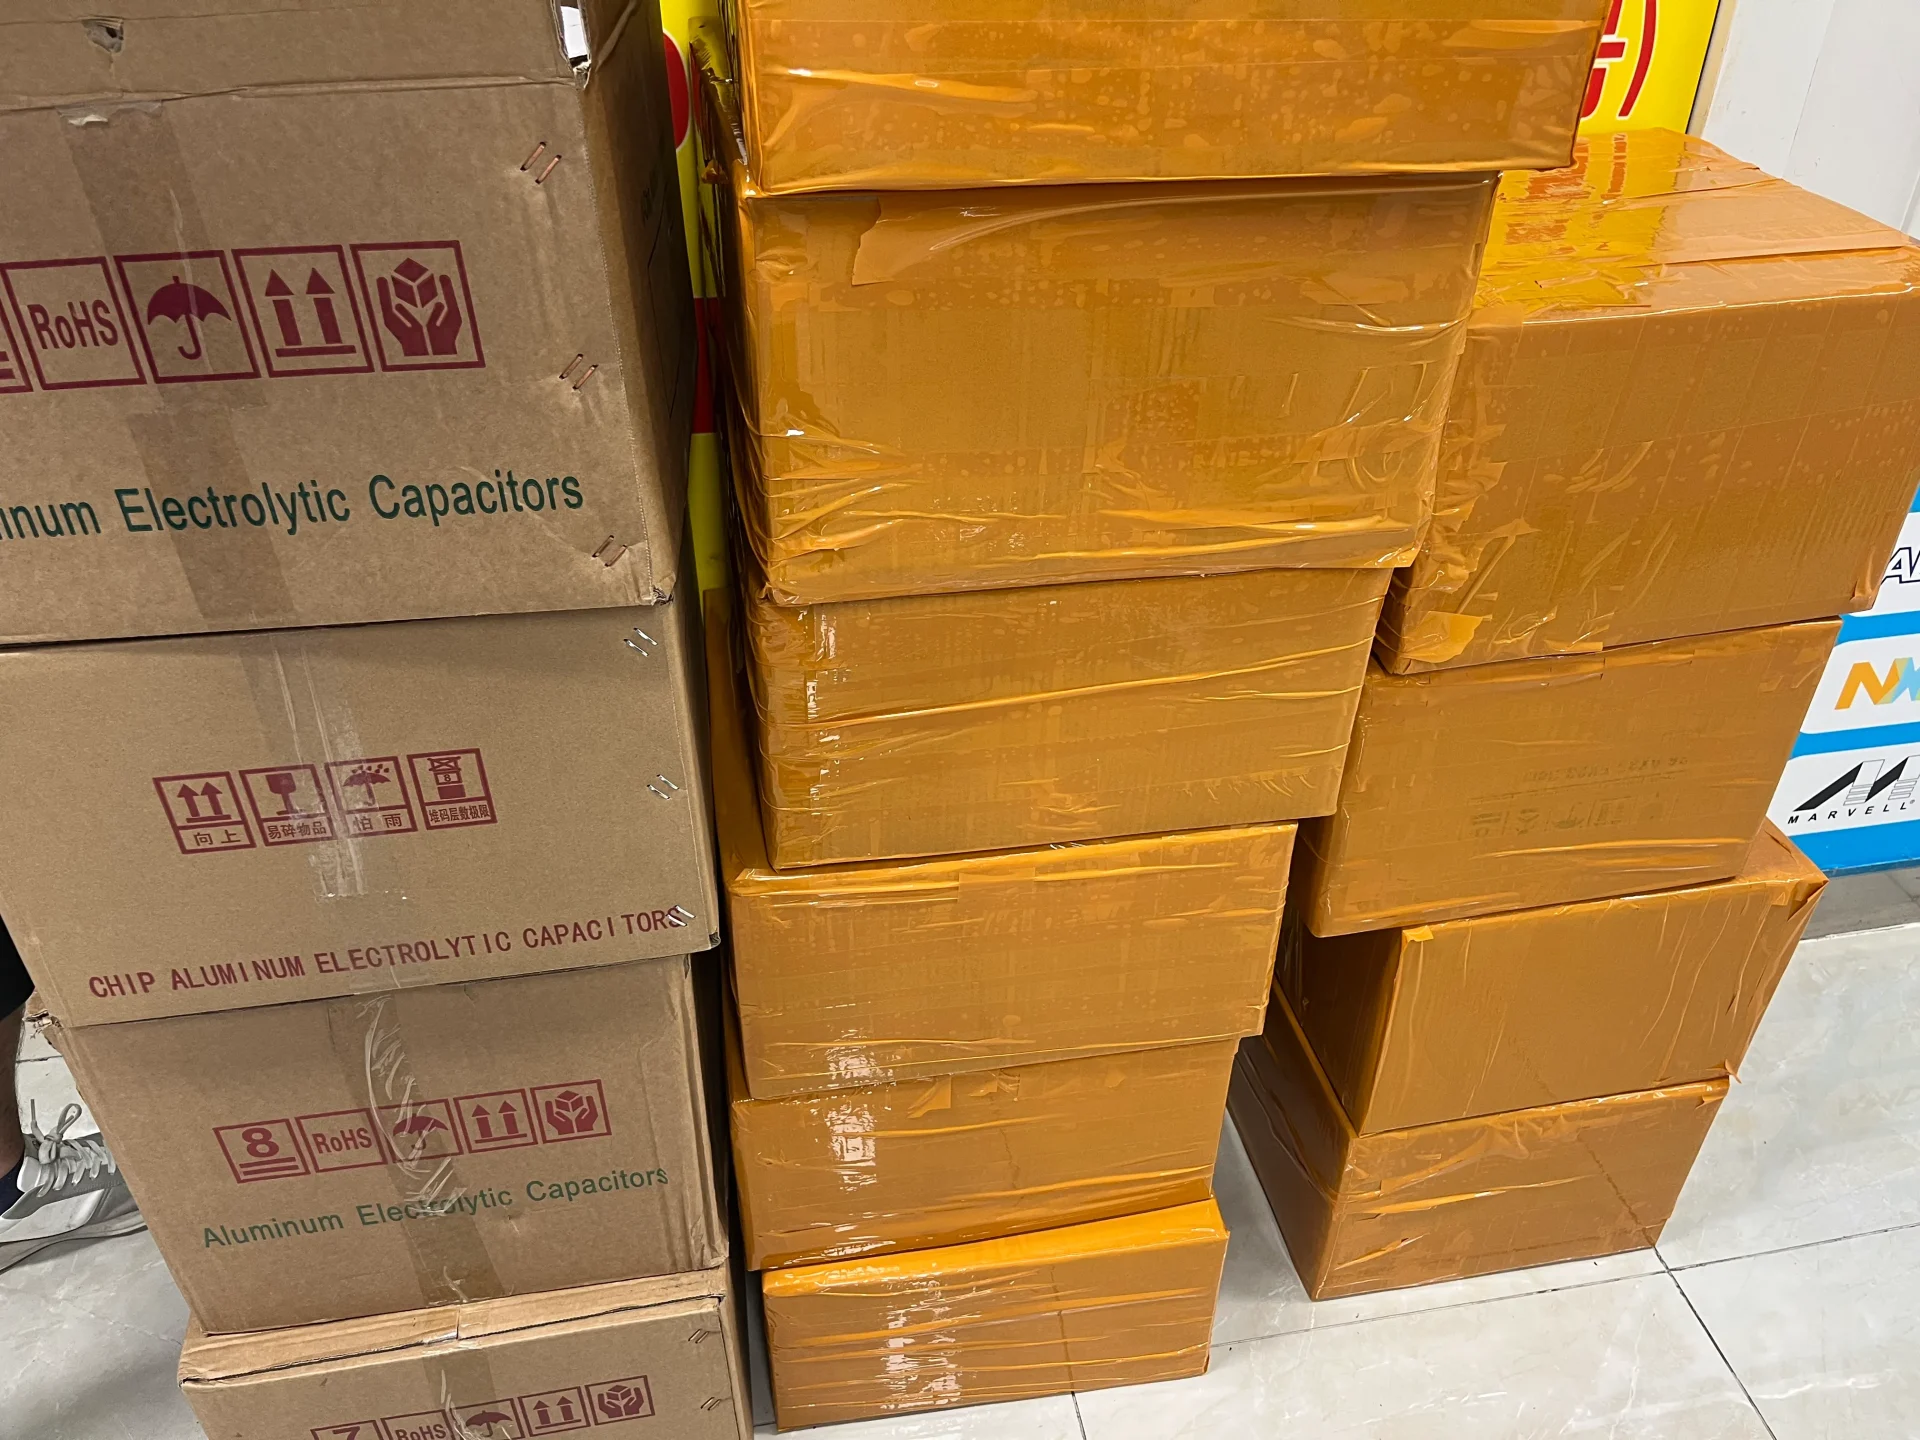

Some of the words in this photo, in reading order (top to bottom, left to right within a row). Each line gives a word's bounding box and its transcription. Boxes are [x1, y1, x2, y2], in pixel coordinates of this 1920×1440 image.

[27, 299, 119, 350] RoHS
[0, 501, 101, 539] inum
[114, 478, 350, 536] Electrolytic
[369, 469, 583, 527] Capacitors
[353, 812, 403, 832] 怕雨
[428, 804, 491, 825] 堆码层数极限
[193, 829, 241, 846] 向上
[267, 820, 327, 840] 易碎物品
[89, 971, 156, 999] CHIP
[170, 955, 306, 991] ALUMINUM
[313, 931, 512, 974] ELECTROLYTIC
[522, 906, 684, 949] CAPACITORS
[241, 1127, 280, 1158] 8
[311, 1127, 373, 1155] RoHS
[203, 1214, 345, 1249] Aluminum
[525, 1166, 669, 1203] Capacitors
